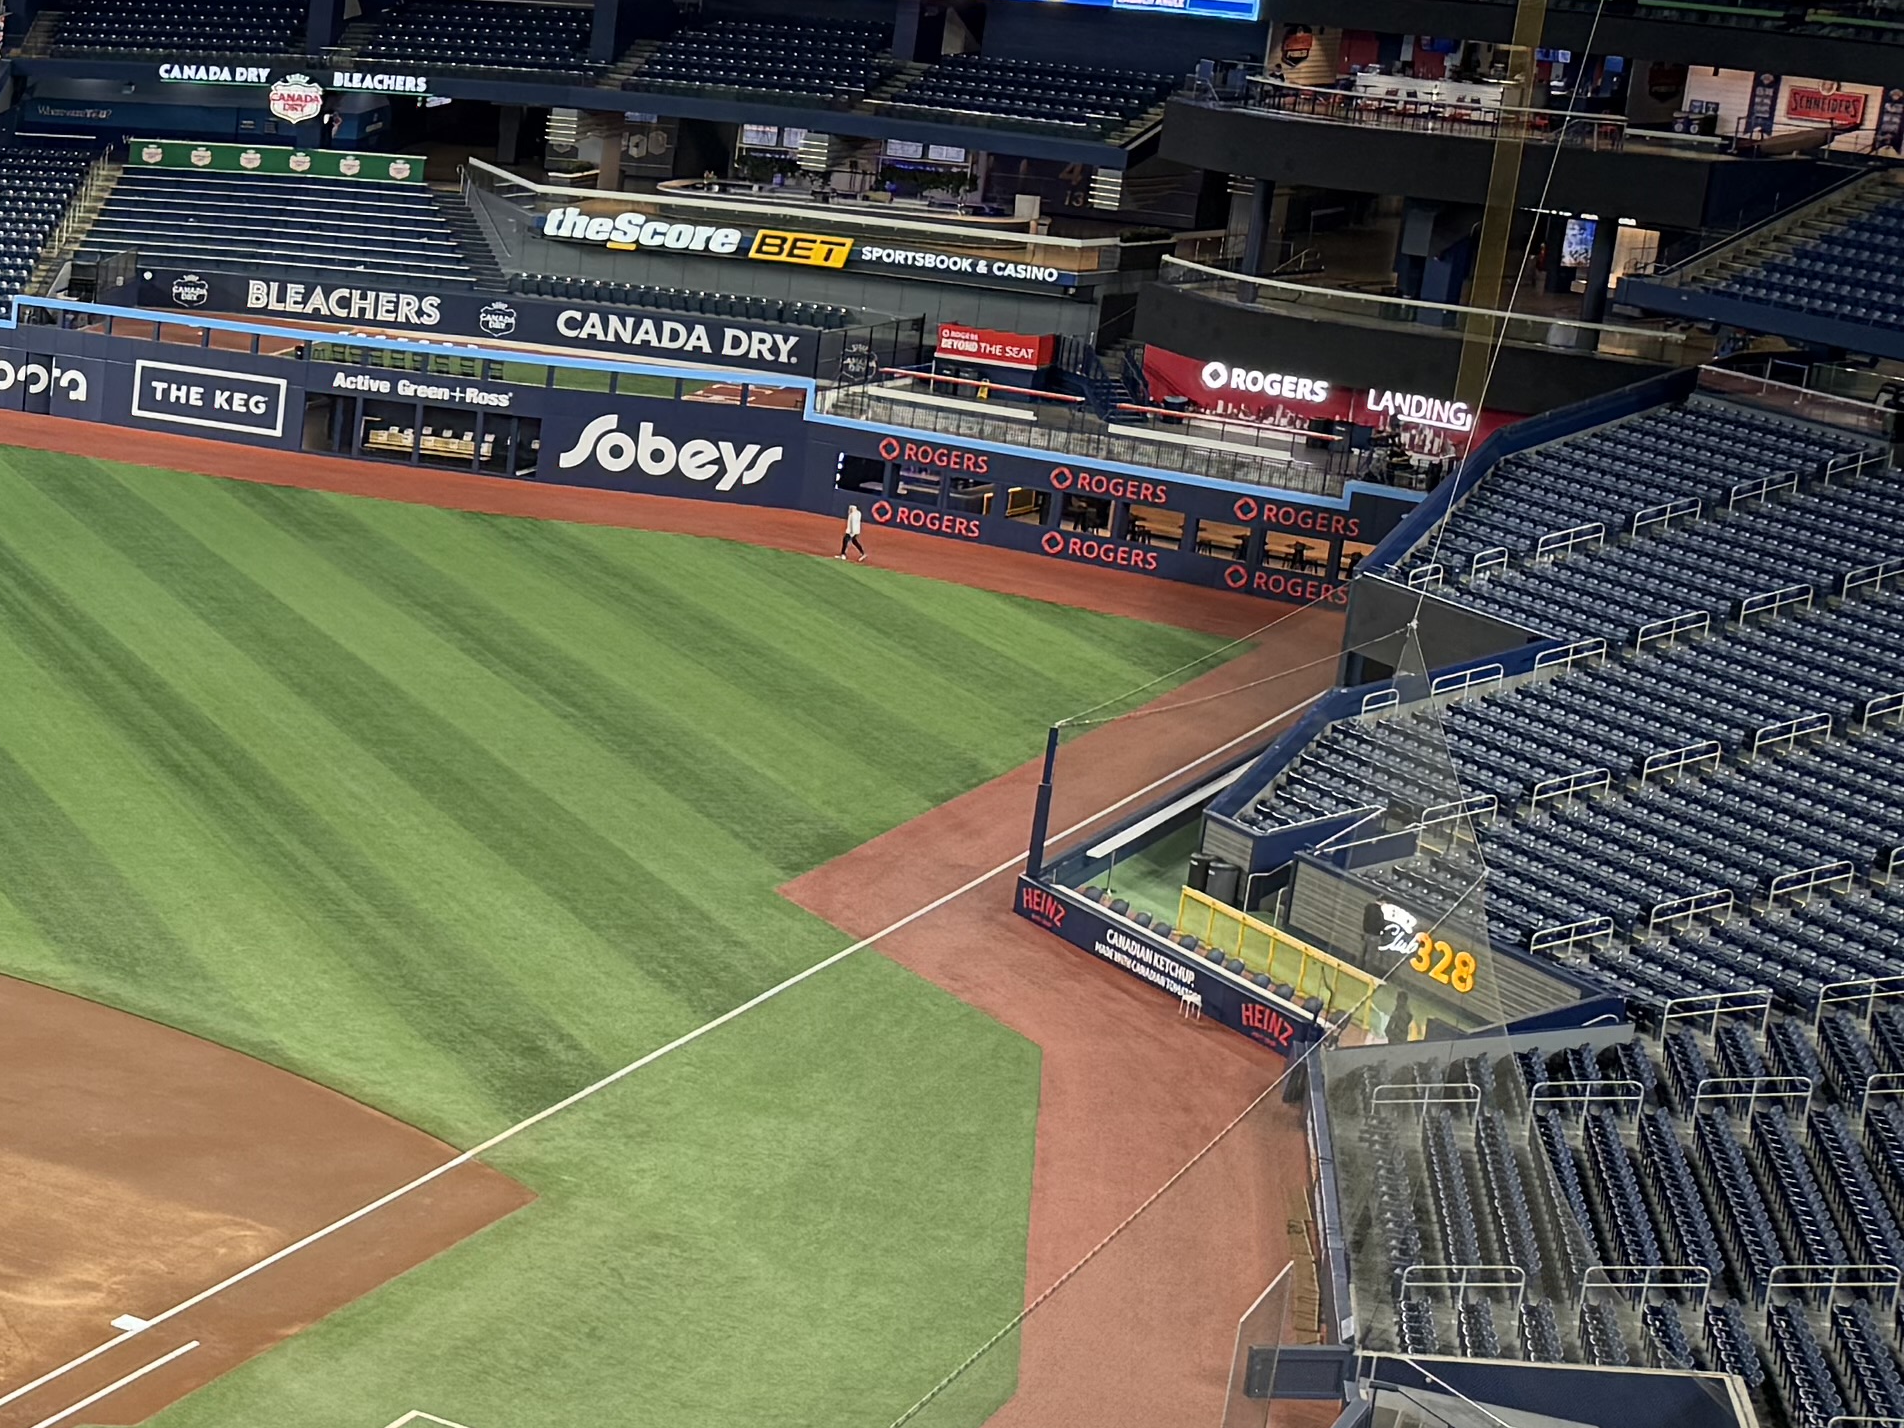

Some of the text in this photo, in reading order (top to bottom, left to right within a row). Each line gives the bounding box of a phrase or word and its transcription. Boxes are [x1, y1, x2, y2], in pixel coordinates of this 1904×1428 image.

[159, 64, 426, 91] CANADA DRY BLEACHERS
[270, 92, 321, 104] CANADA
[283, 102, 306, 113] DRY
[1792, 91, 1862, 120] SCHNEIDERS
[543, 207, 1057, 282] theScore BET SPORTSBOOK & CASINO
[247, 281, 441, 326] BLEACHERS
[555, 310, 706, 353] CANADA
[941, 339, 1034, 360] BEYOND THE SEAT
[151, 380, 268, 415] THE KEG
[333, 371, 512, 408] Active Green+Ross
[1230, 367, 1469, 428] ROGERS LANDING
[559, 413, 783, 491] Sobeys
[904, 443, 989, 473] ROGERS
[1078, 472, 1167, 504] ROGERS
[896, 506, 980, 538] ROGERS
[1263, 504, 1360, 536] ROGERS
[1069, 538, 1157, 570] ROGERS
[1254, 572, 1348, 605] ROGERS
[1022, 886, 1065, 928] HEINZ
[1106, 928, 1154, 962] CANADIAN
[1410, 932, 1477, 993] 328
[1241, 1003, 1294, 1046] HEINZ
